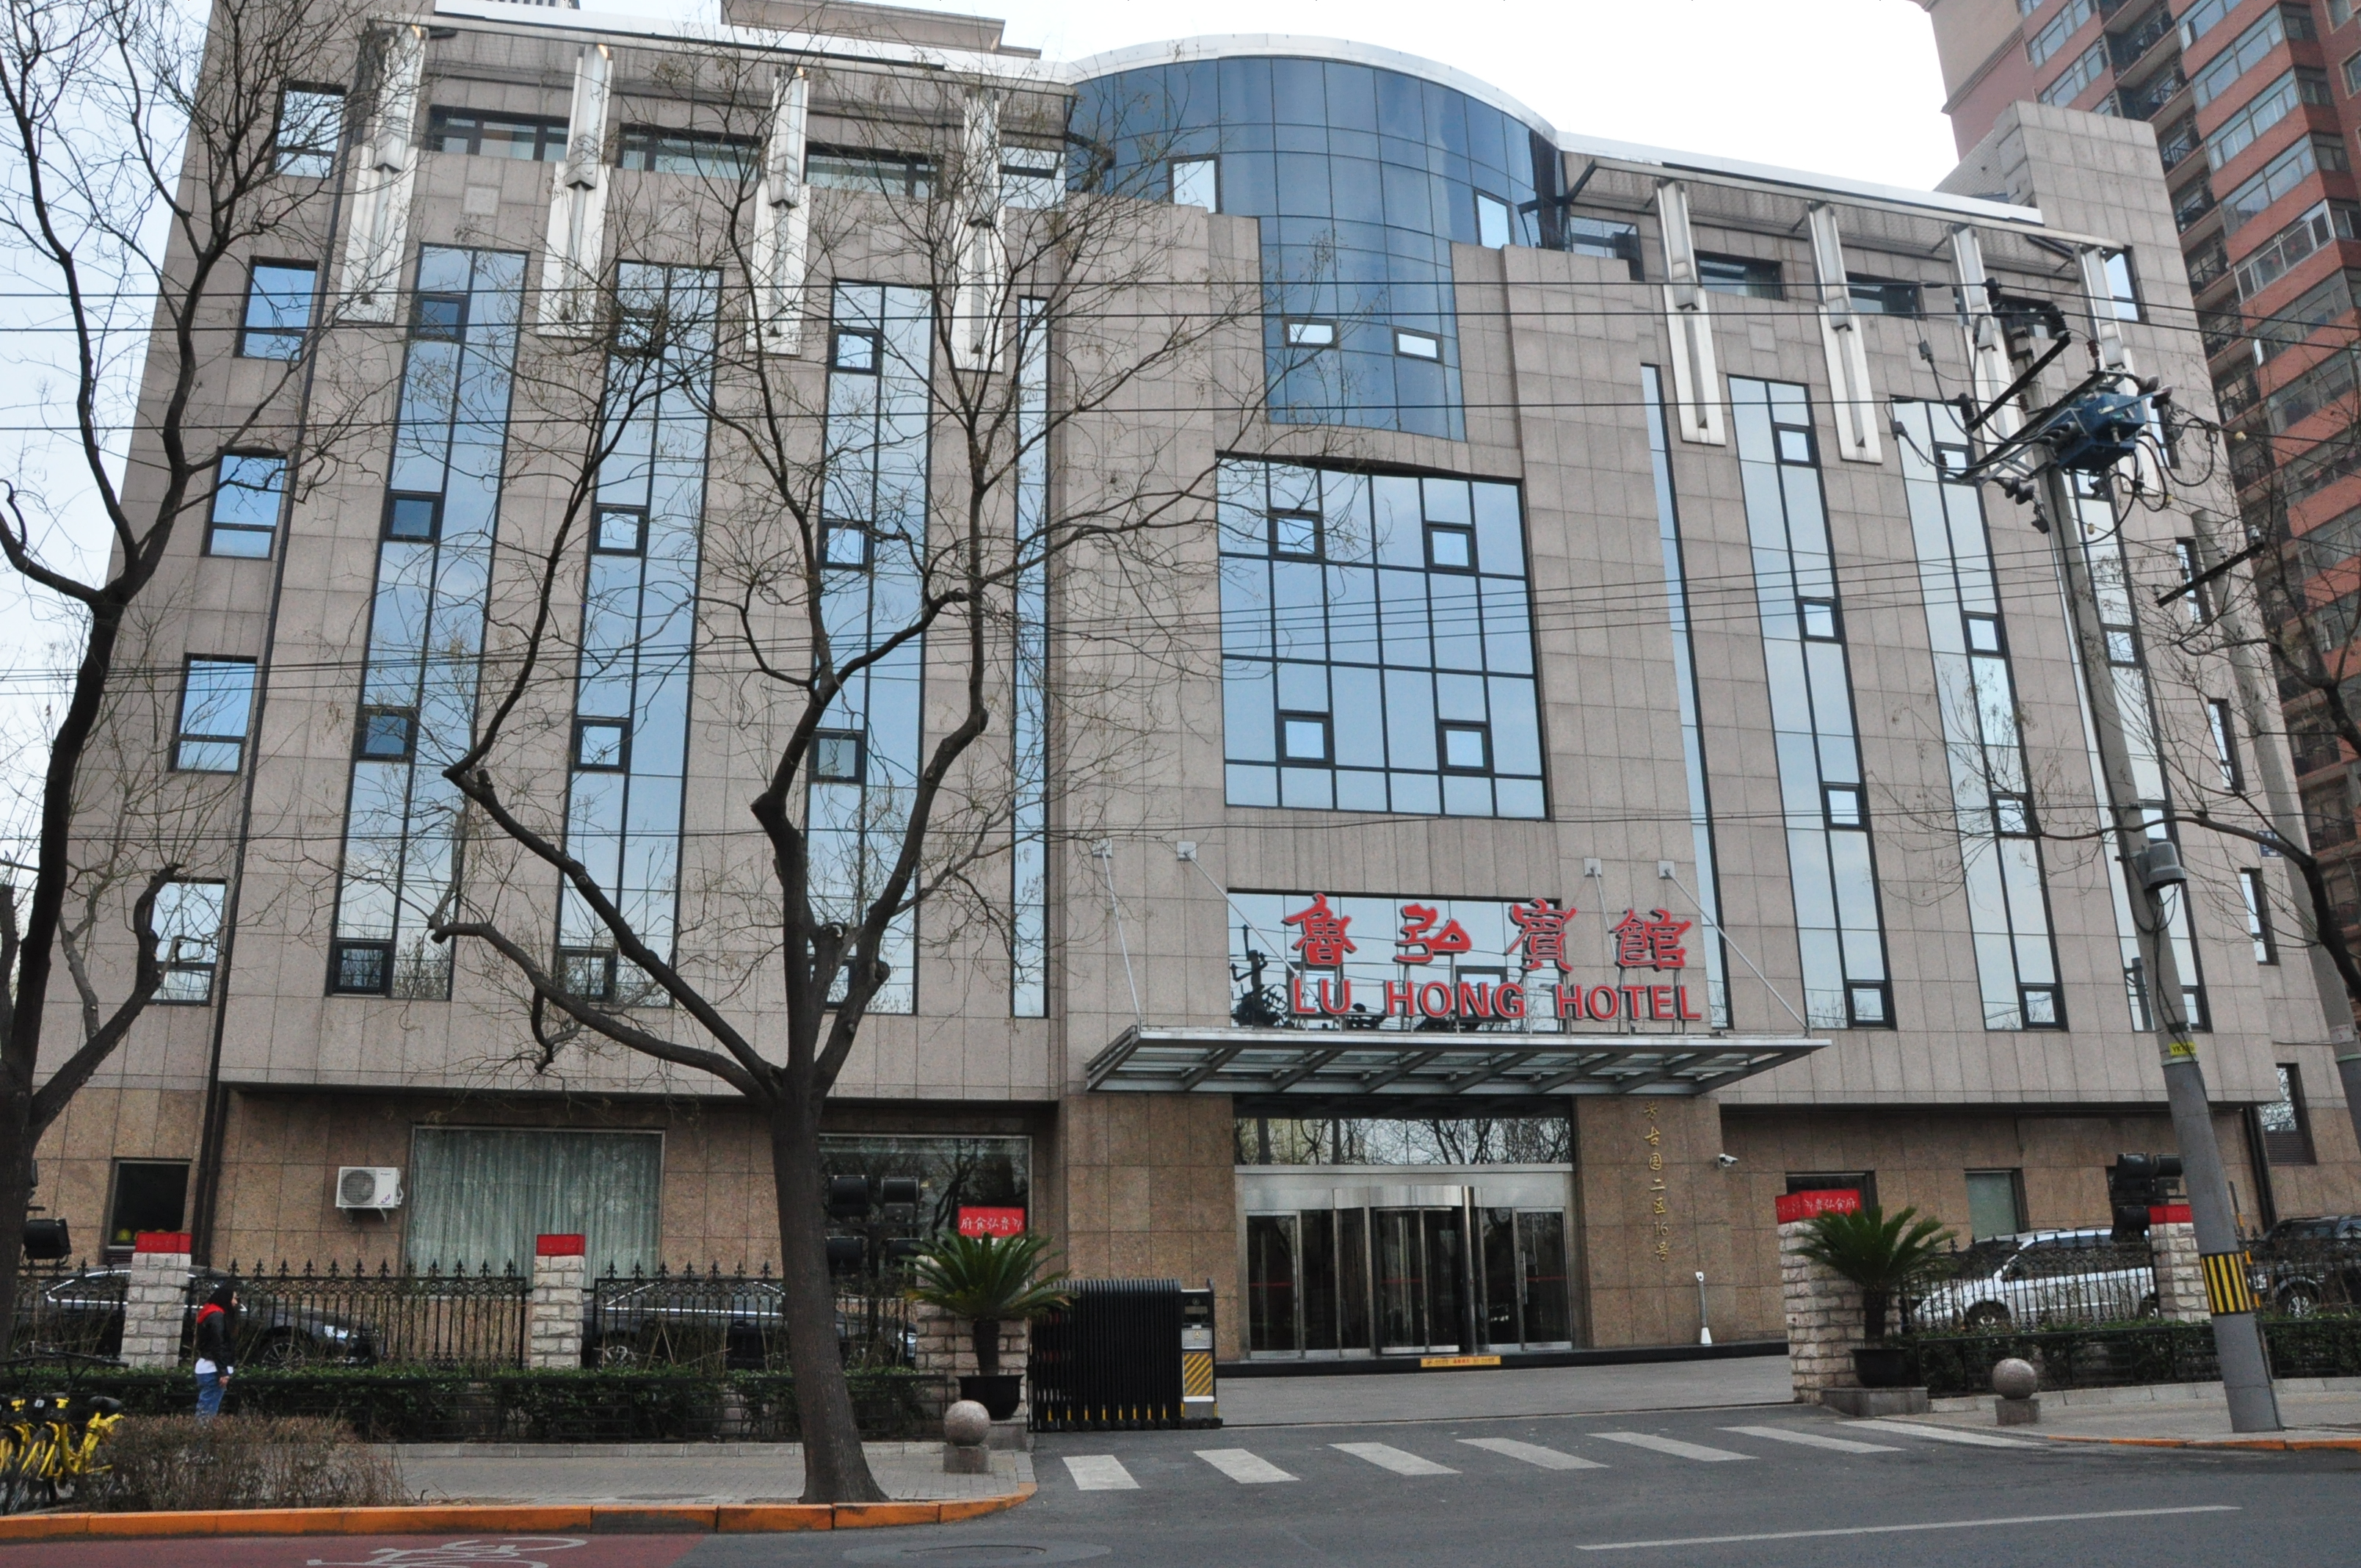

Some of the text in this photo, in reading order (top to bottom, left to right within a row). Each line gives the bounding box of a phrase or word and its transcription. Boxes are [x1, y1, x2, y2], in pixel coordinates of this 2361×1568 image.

[1290, 977, 1702, 1022] LU HONG HOTEL
